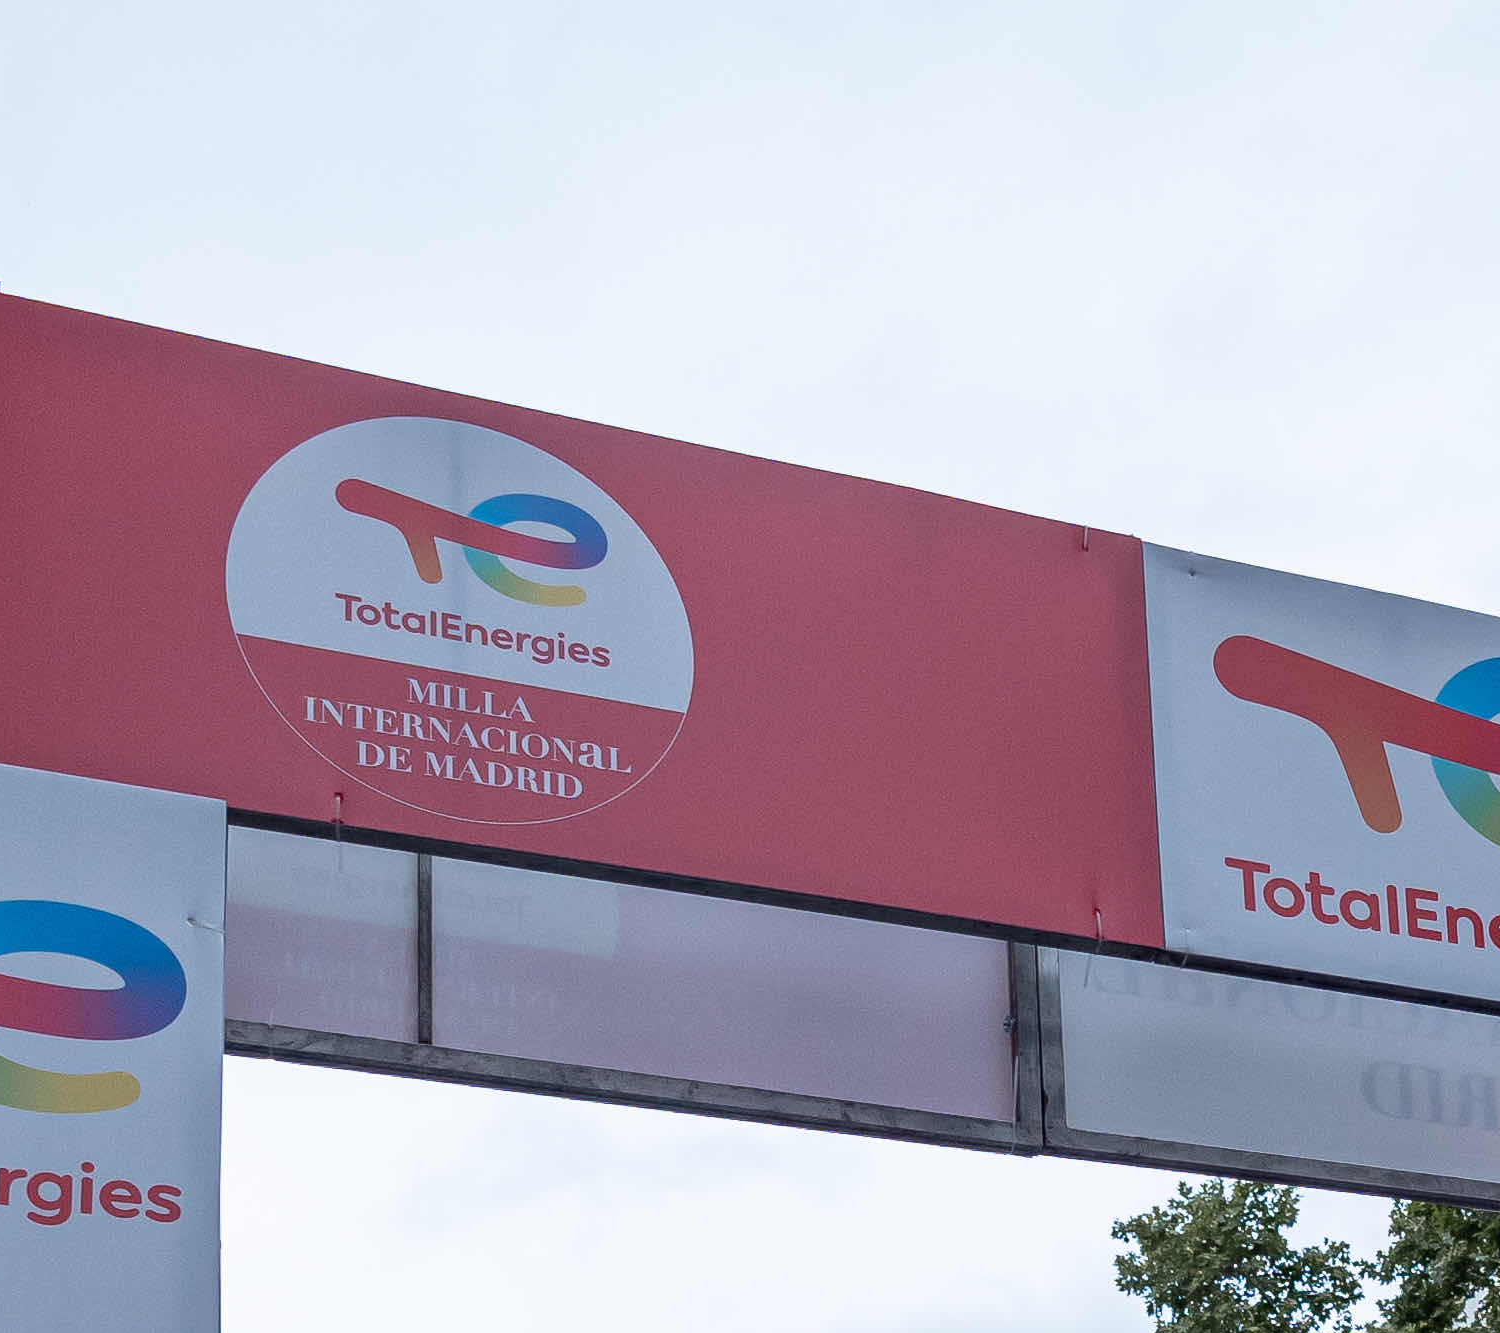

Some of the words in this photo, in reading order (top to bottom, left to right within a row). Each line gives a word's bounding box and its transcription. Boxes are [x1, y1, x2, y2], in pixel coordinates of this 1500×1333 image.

[335, 592, 611, 668] TotalEnergies
[407, 678, 535, 724] MILLA
[356, 740, 412, 774] DE
[424, 751, 584, 799] MADRID
